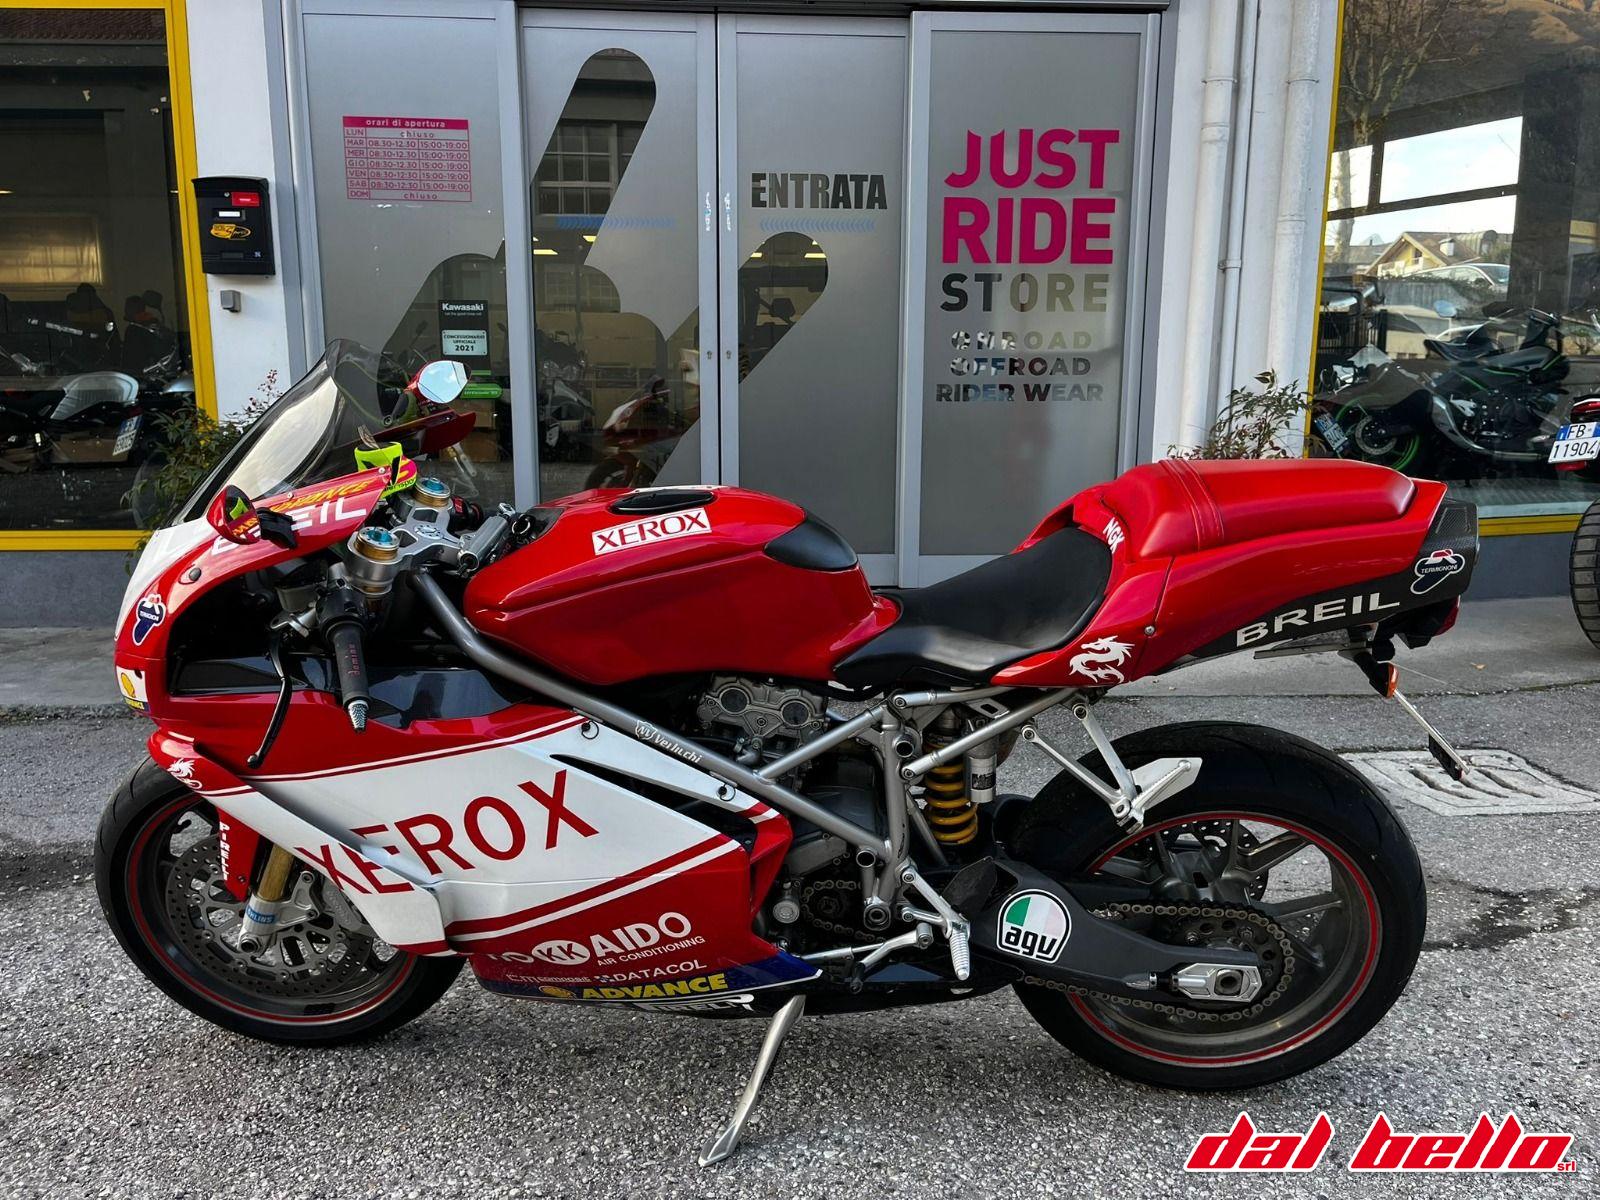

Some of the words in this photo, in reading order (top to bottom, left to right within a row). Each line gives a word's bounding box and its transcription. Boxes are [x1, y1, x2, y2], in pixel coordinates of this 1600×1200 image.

[346, 128, 364, 136] LUN
[400, 130, 435, 138] chiuso
[404, 120, 446, 128] apertura
[944, 128, 1120, 189] JUST
[751, 172, 888, 210] ENTRATA
[942, 197, 1116, 265] RIDE
[940, 272, 1110, 312] STORE
[442, 302, 484, 311] Kawasaki
[950, 357, 1091, 376] OFFROAD
[936, 383, 1015, 402] RIDER
[1023, 383, 1104, 402] WEAR
[1567, 425, 1586, 439] FB
[1553, 440, 1598, 458] 11904
[596, 511, 710, 551] XEROX
[1103, 516, 1125, 554] NGK
[1421, 564, 1458, 574] TERMIGNONI
[1236, 592, 1400, 648] BREIL
[293, 770, 599, 895] XEROX
[597, 957, 617, 967] AIR
[620, 935, 706, 962] CONDITIONING
[1004, 926, 1058, 956] agv
[613, 959, 708, 982] DATACOL
[583, 973, 729, 999] ADVANCE
